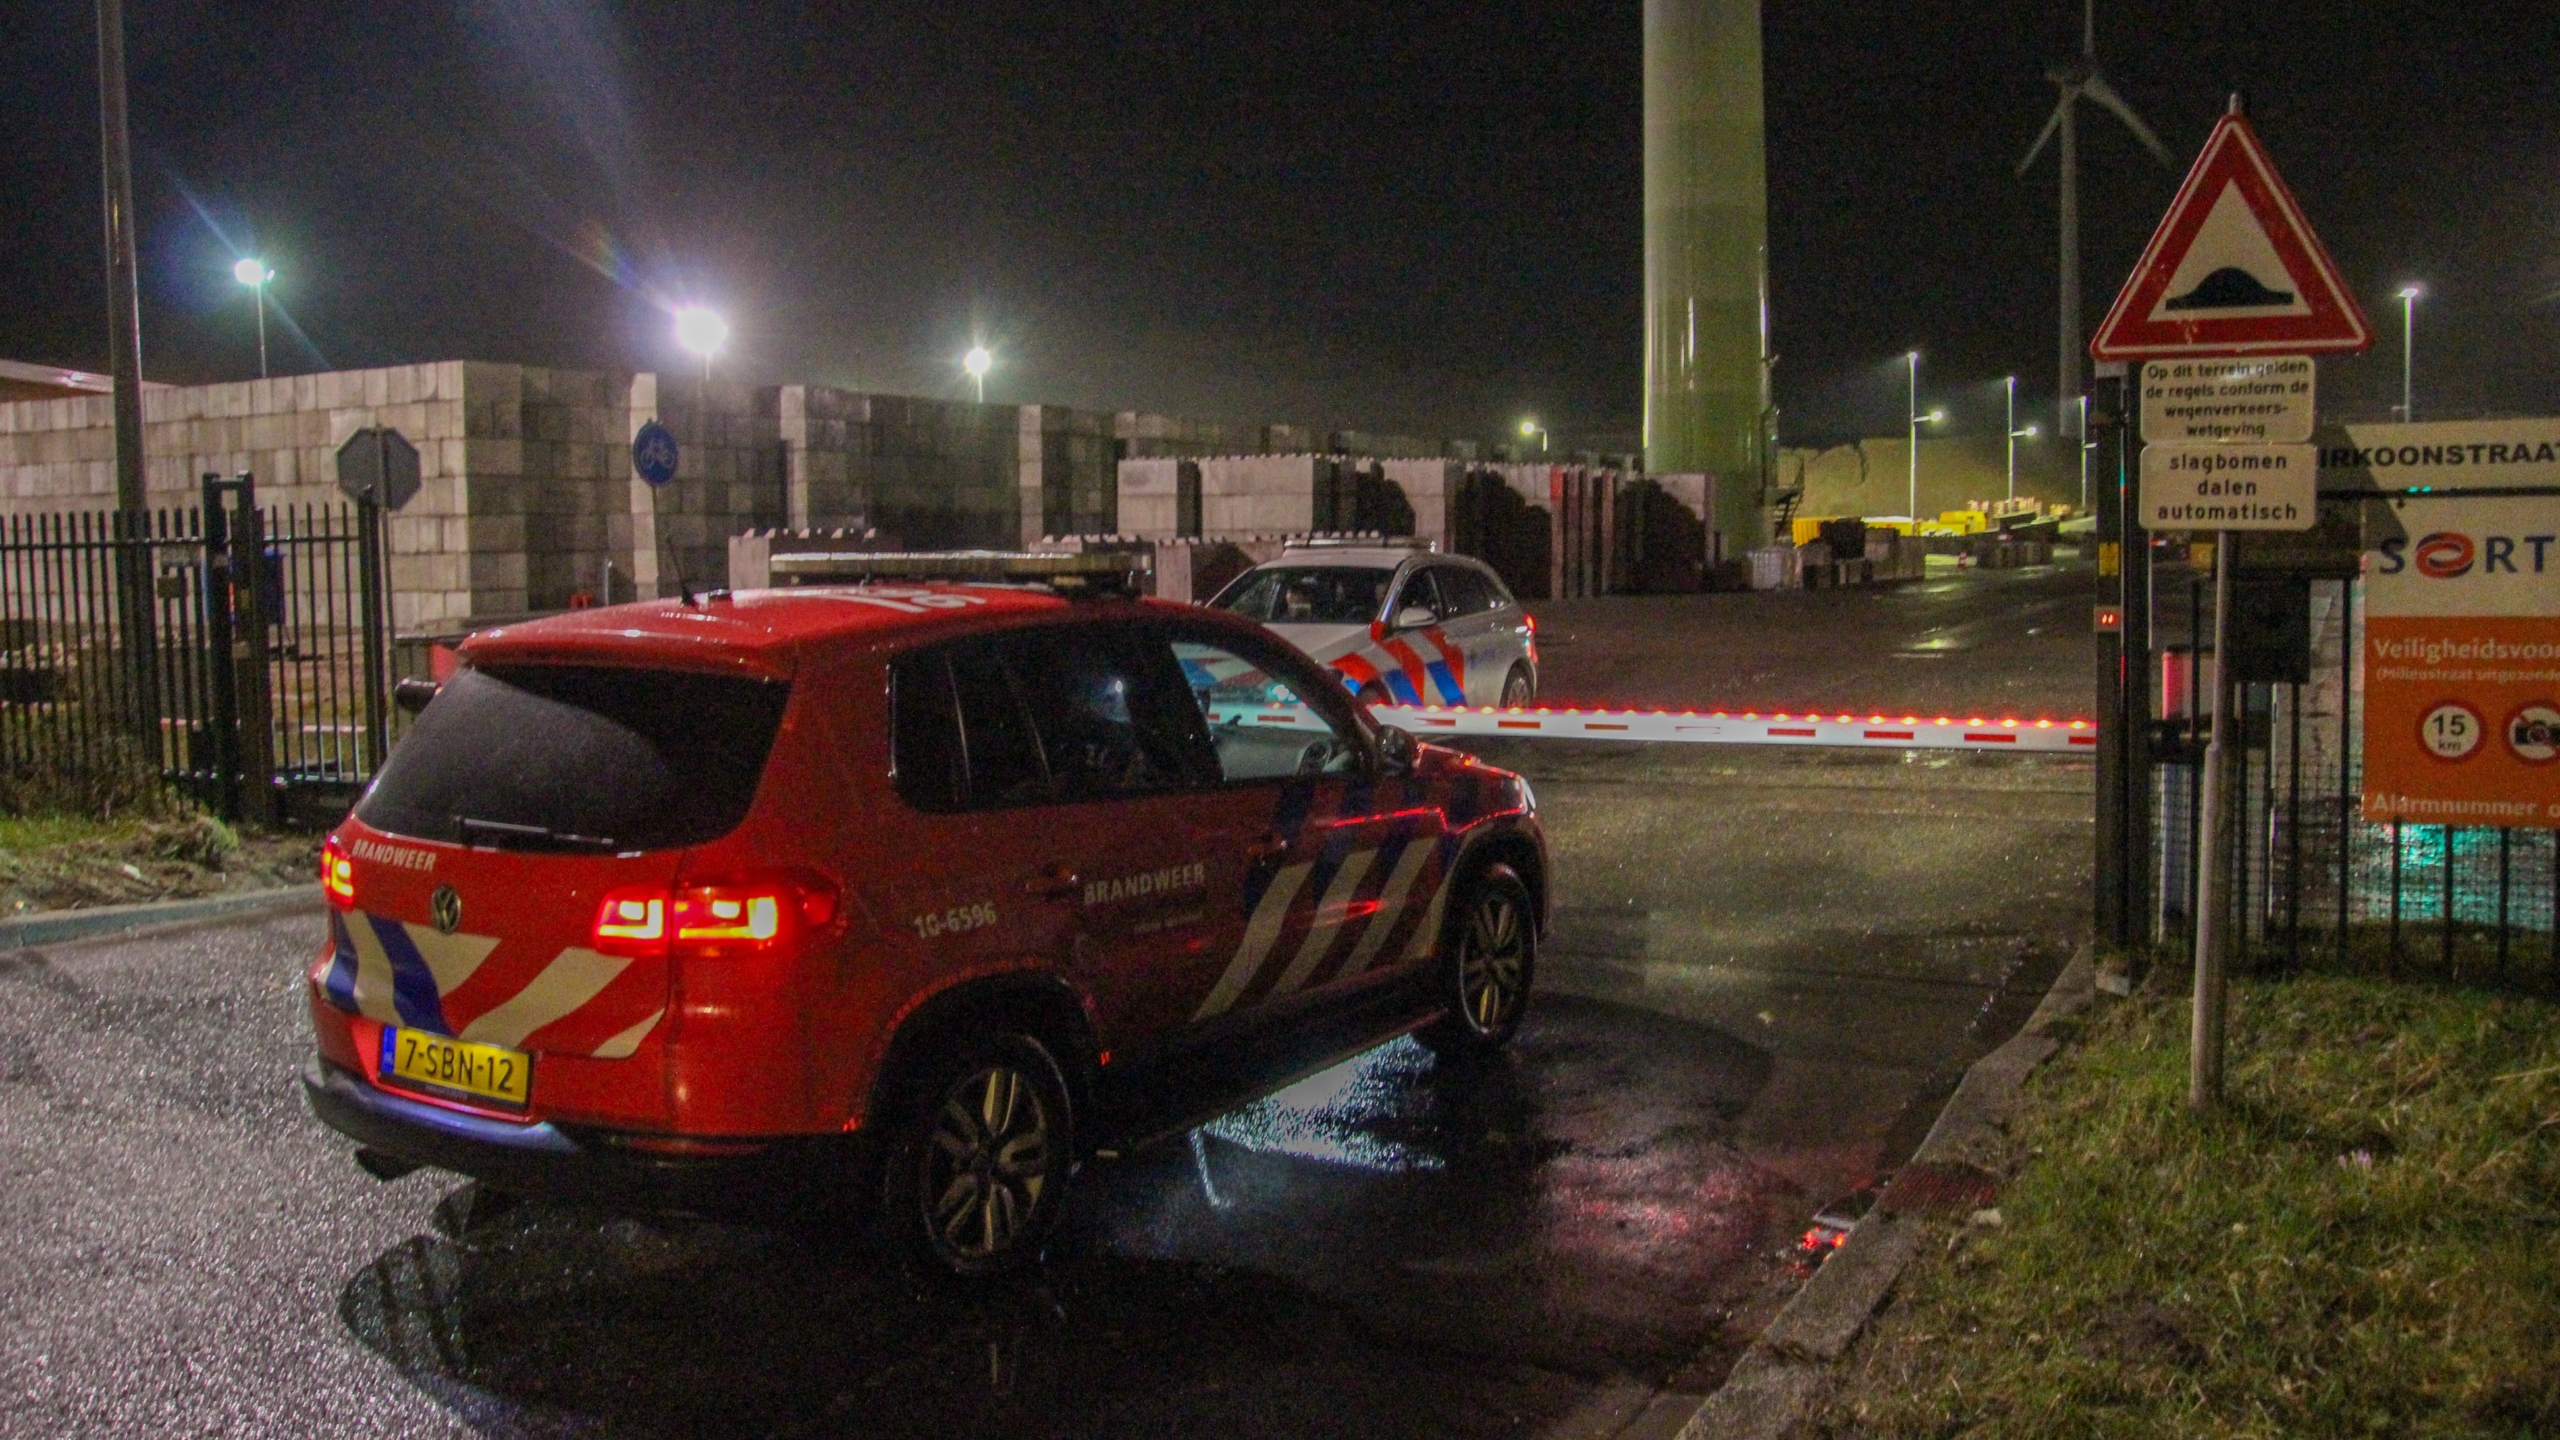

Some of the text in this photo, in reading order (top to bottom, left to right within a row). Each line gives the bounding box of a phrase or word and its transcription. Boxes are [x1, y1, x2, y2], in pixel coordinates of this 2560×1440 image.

[2148, 360, 2309, 382] Op dit terrein gelden
[2146, 380, 2309, 400] de regels conform de
[2164, 402, 2289, 420] wegenverkeers-
[2186, 424, 2266, 439] wetgeving
[2169, 453, 2288, 475] slagbomen
[2197, 478, 2257, 496] dalen
[2158, 503, 2297, 520] automatisch
[2431, 714, 2466, 737] 15
[2437, 738, 2462, 751] km
[2371, 792, 2538, 817] Alarmnummer
[351, 839, 437, 872] BRANDWEER
[1083, 862, 1206, 906] BRANDWEER
[913, 900, 998, 940] 10-6596
[404, 1038, 514, 1092] 7-SBN-12
